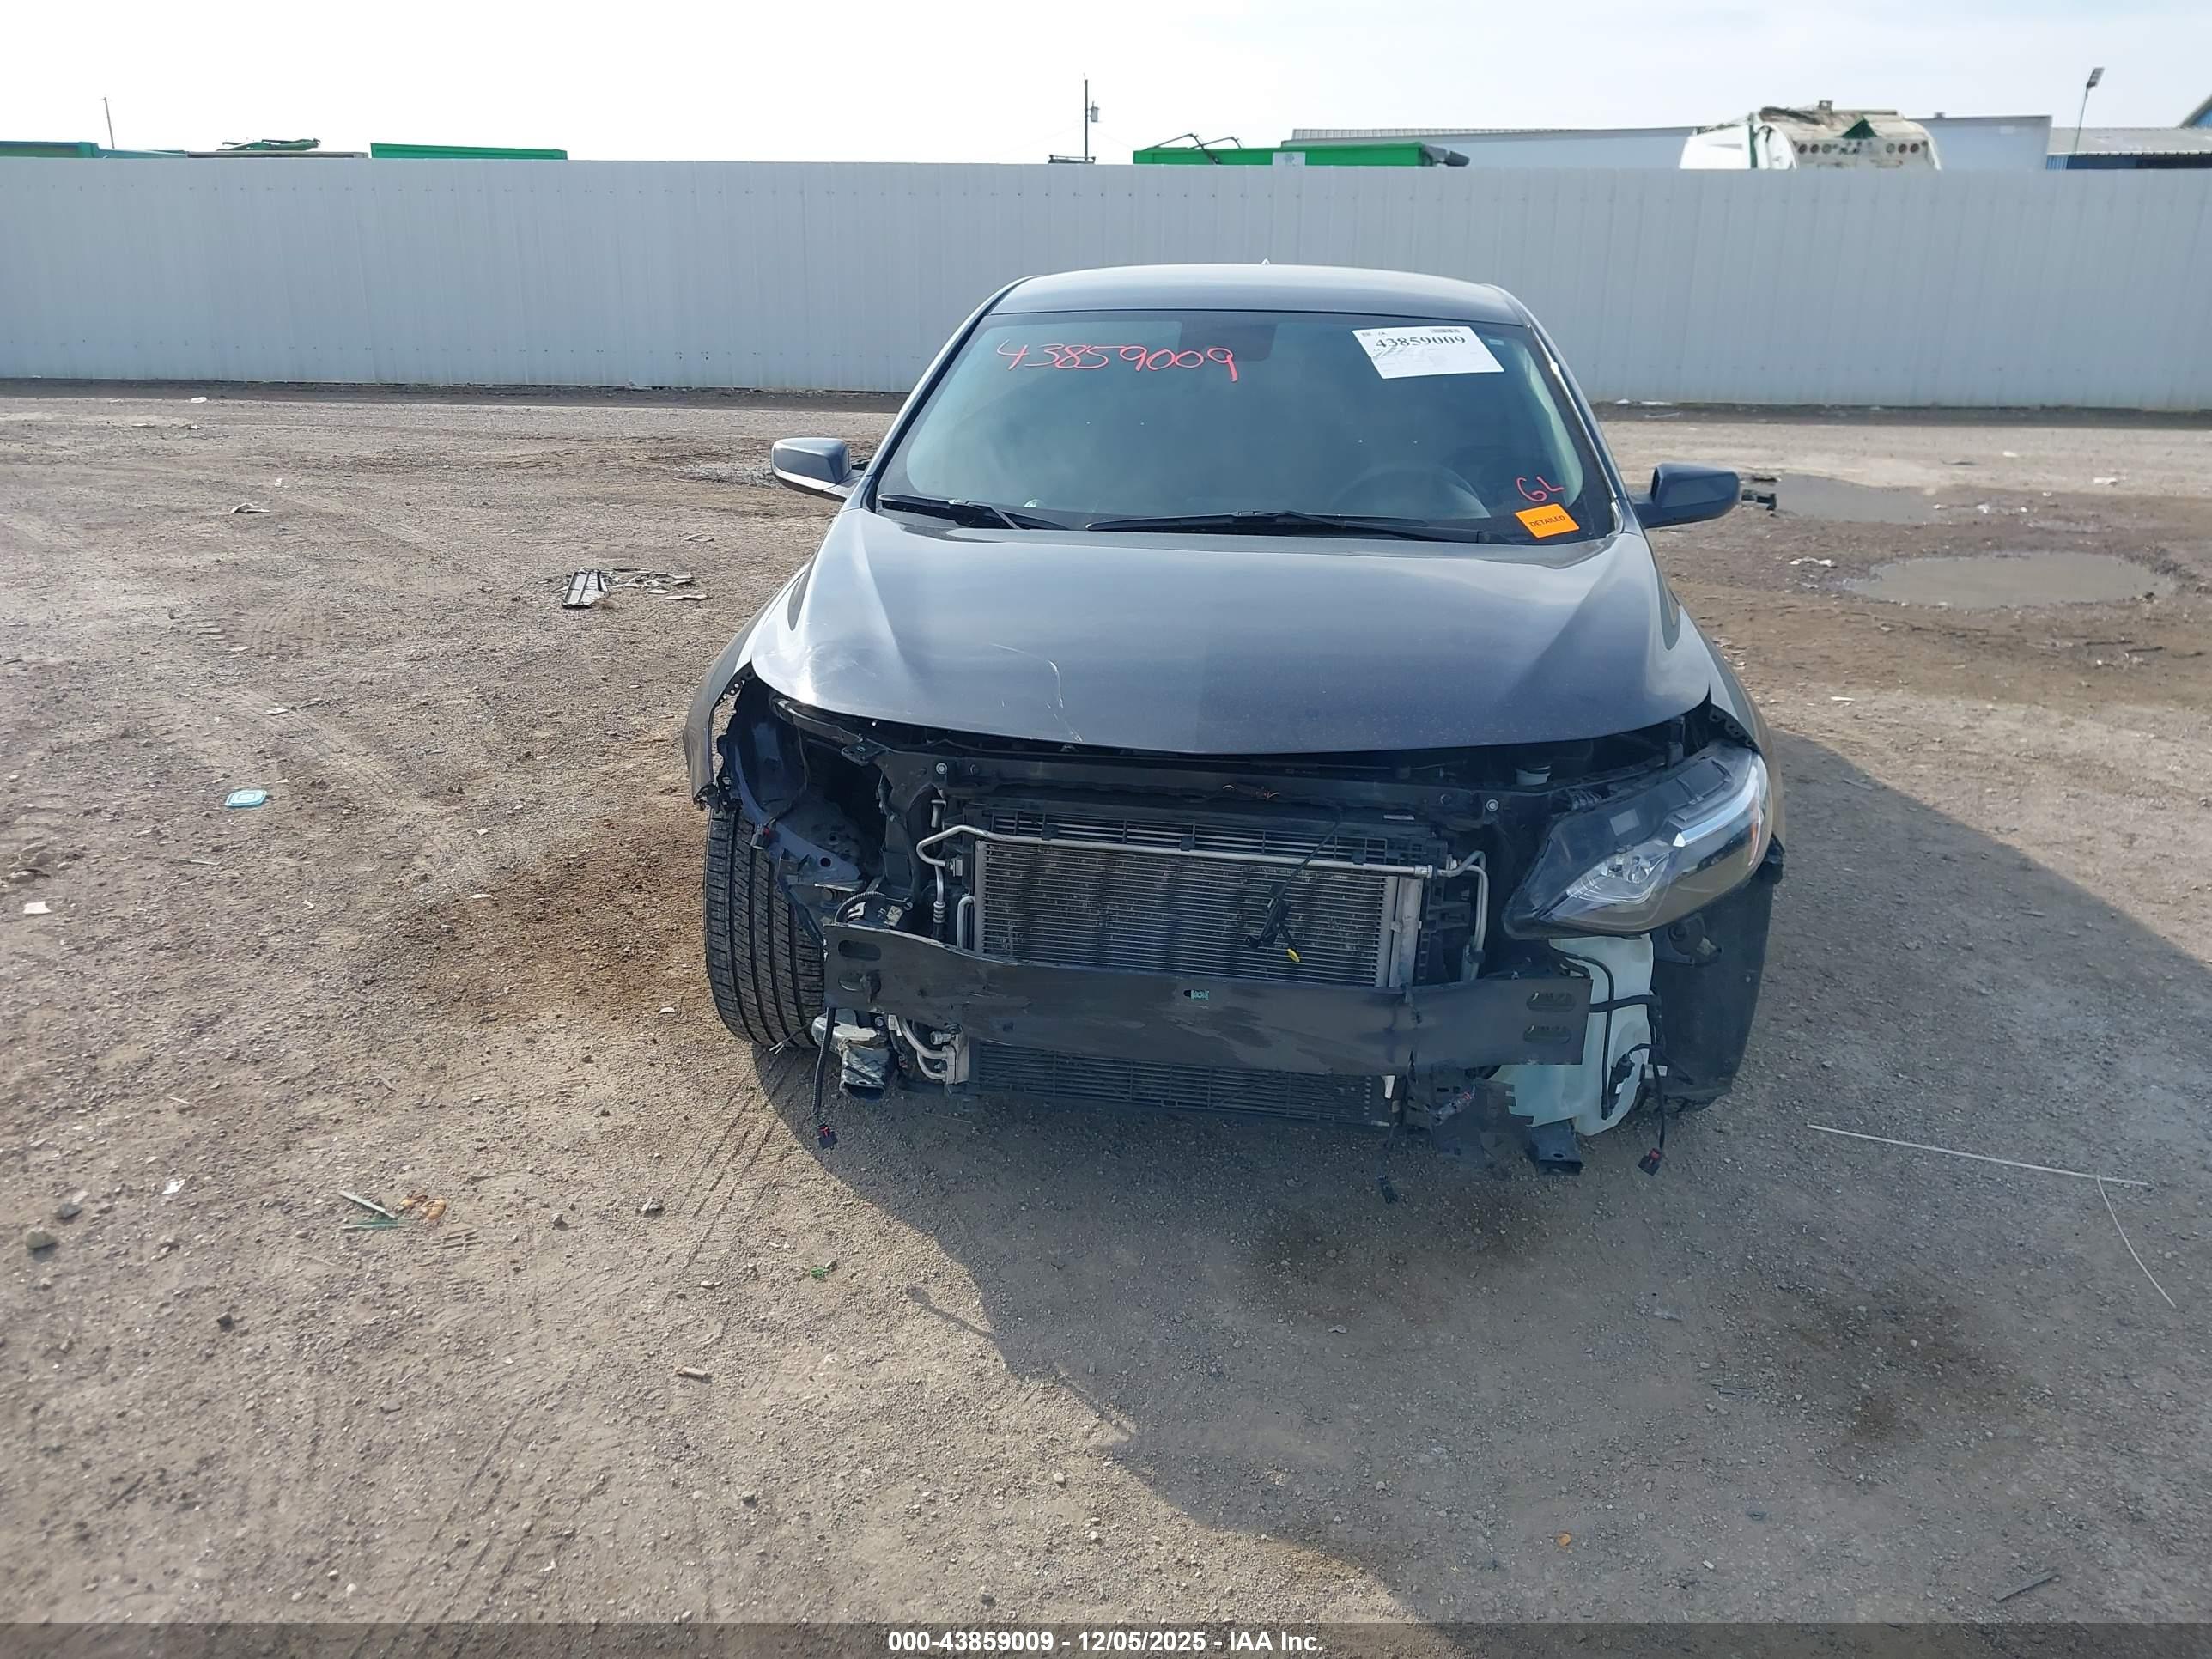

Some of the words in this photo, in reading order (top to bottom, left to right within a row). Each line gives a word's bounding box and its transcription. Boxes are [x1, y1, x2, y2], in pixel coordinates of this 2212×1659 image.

[1376, 336, 1466, 348] 43859009
[996, 339, 1238, 382] 43859009
[1529, 514, 1566, 527] DETAILED
